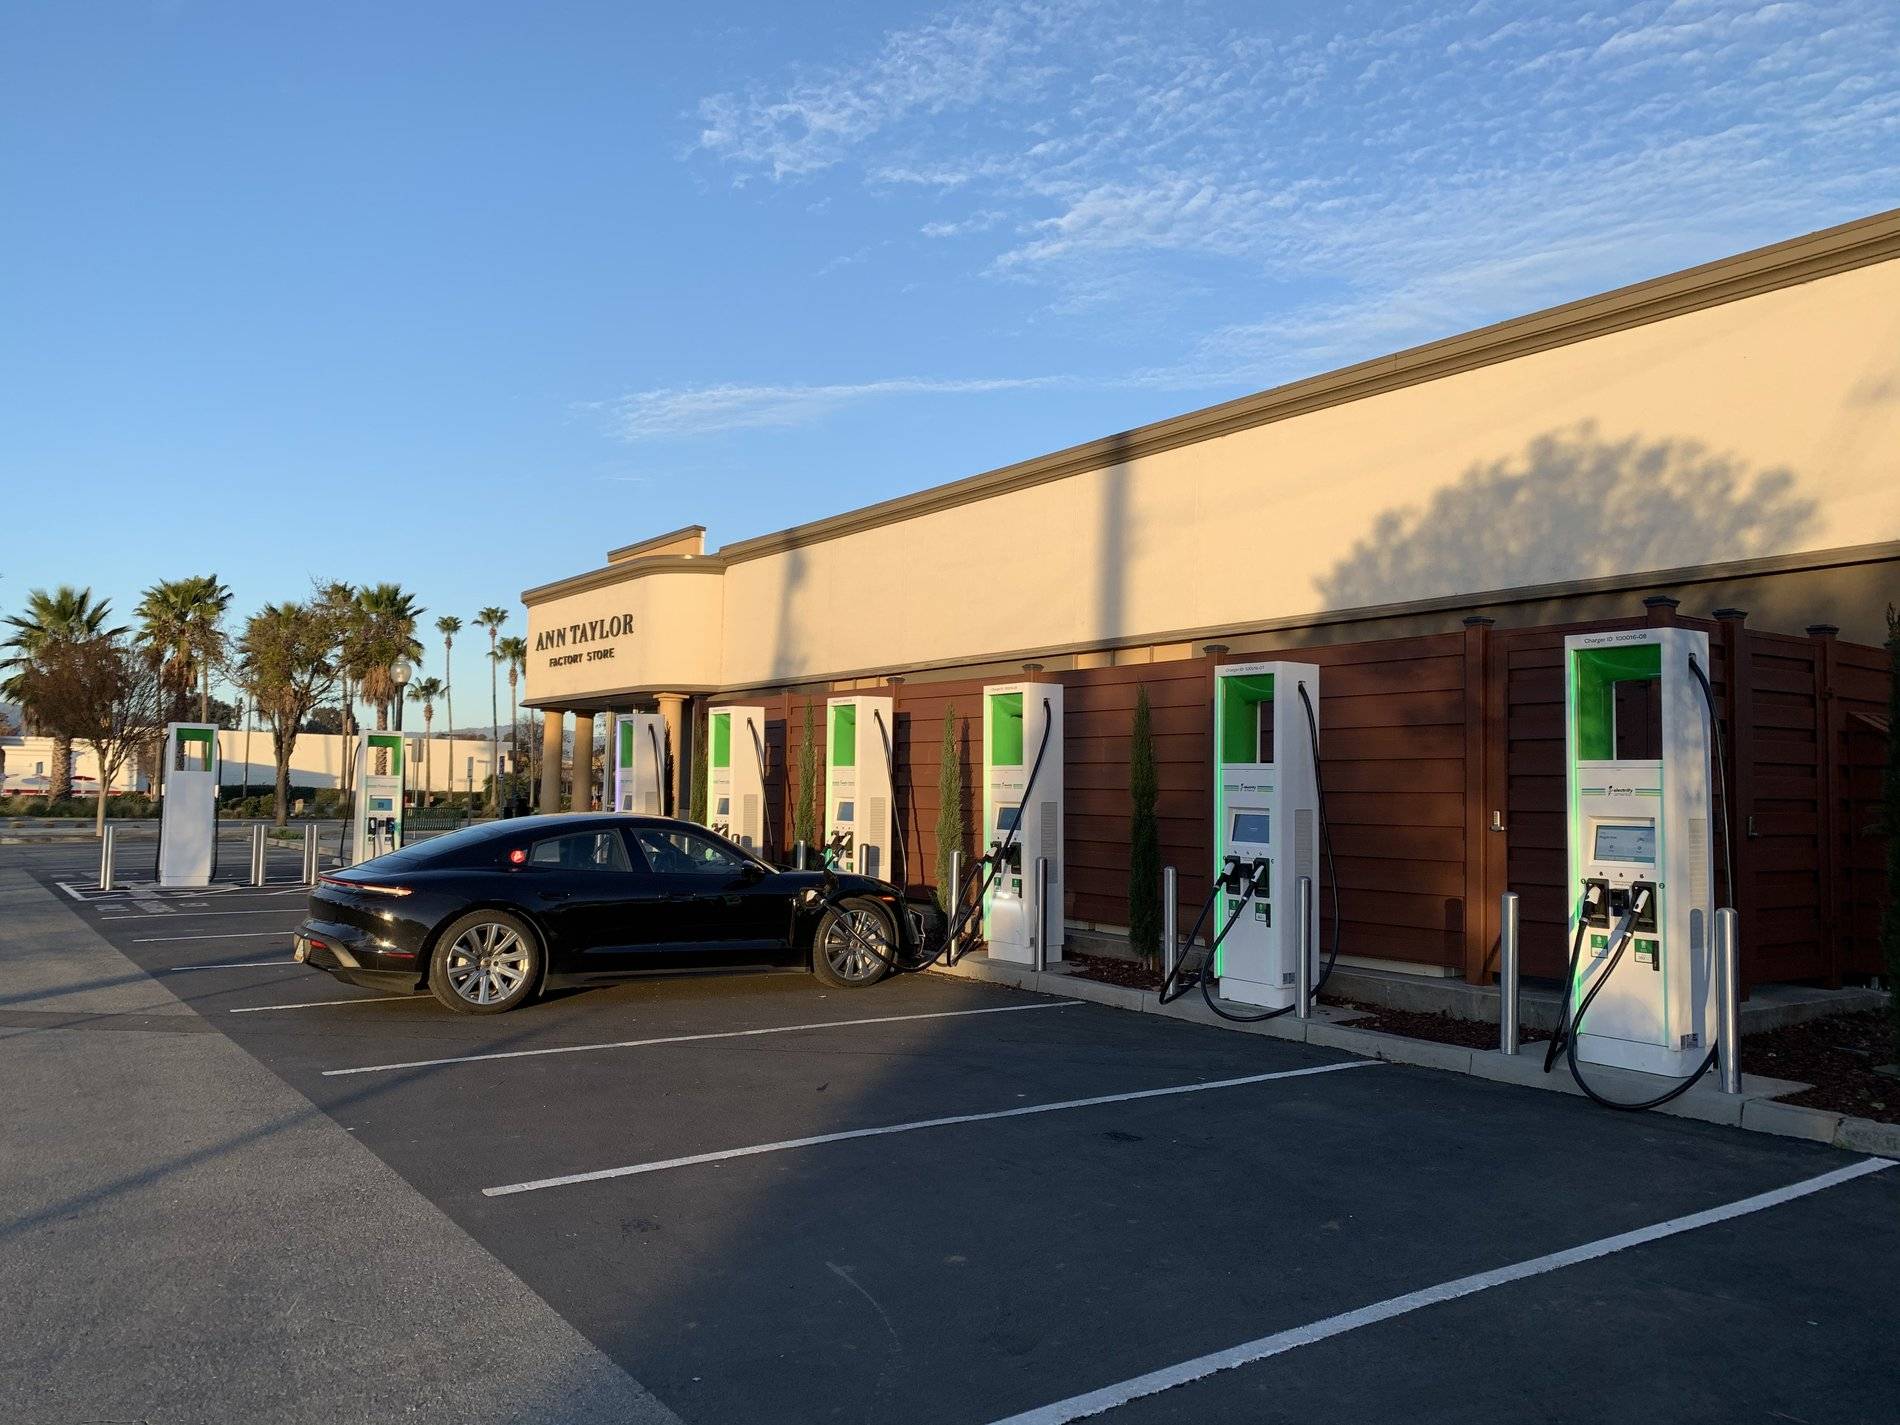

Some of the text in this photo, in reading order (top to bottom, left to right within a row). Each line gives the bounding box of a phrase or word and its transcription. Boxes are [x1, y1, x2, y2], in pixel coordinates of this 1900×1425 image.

[535, 613, 634, 652] ANN TAYLOR
[549, 647, 615, 668] FACTORY STORE
